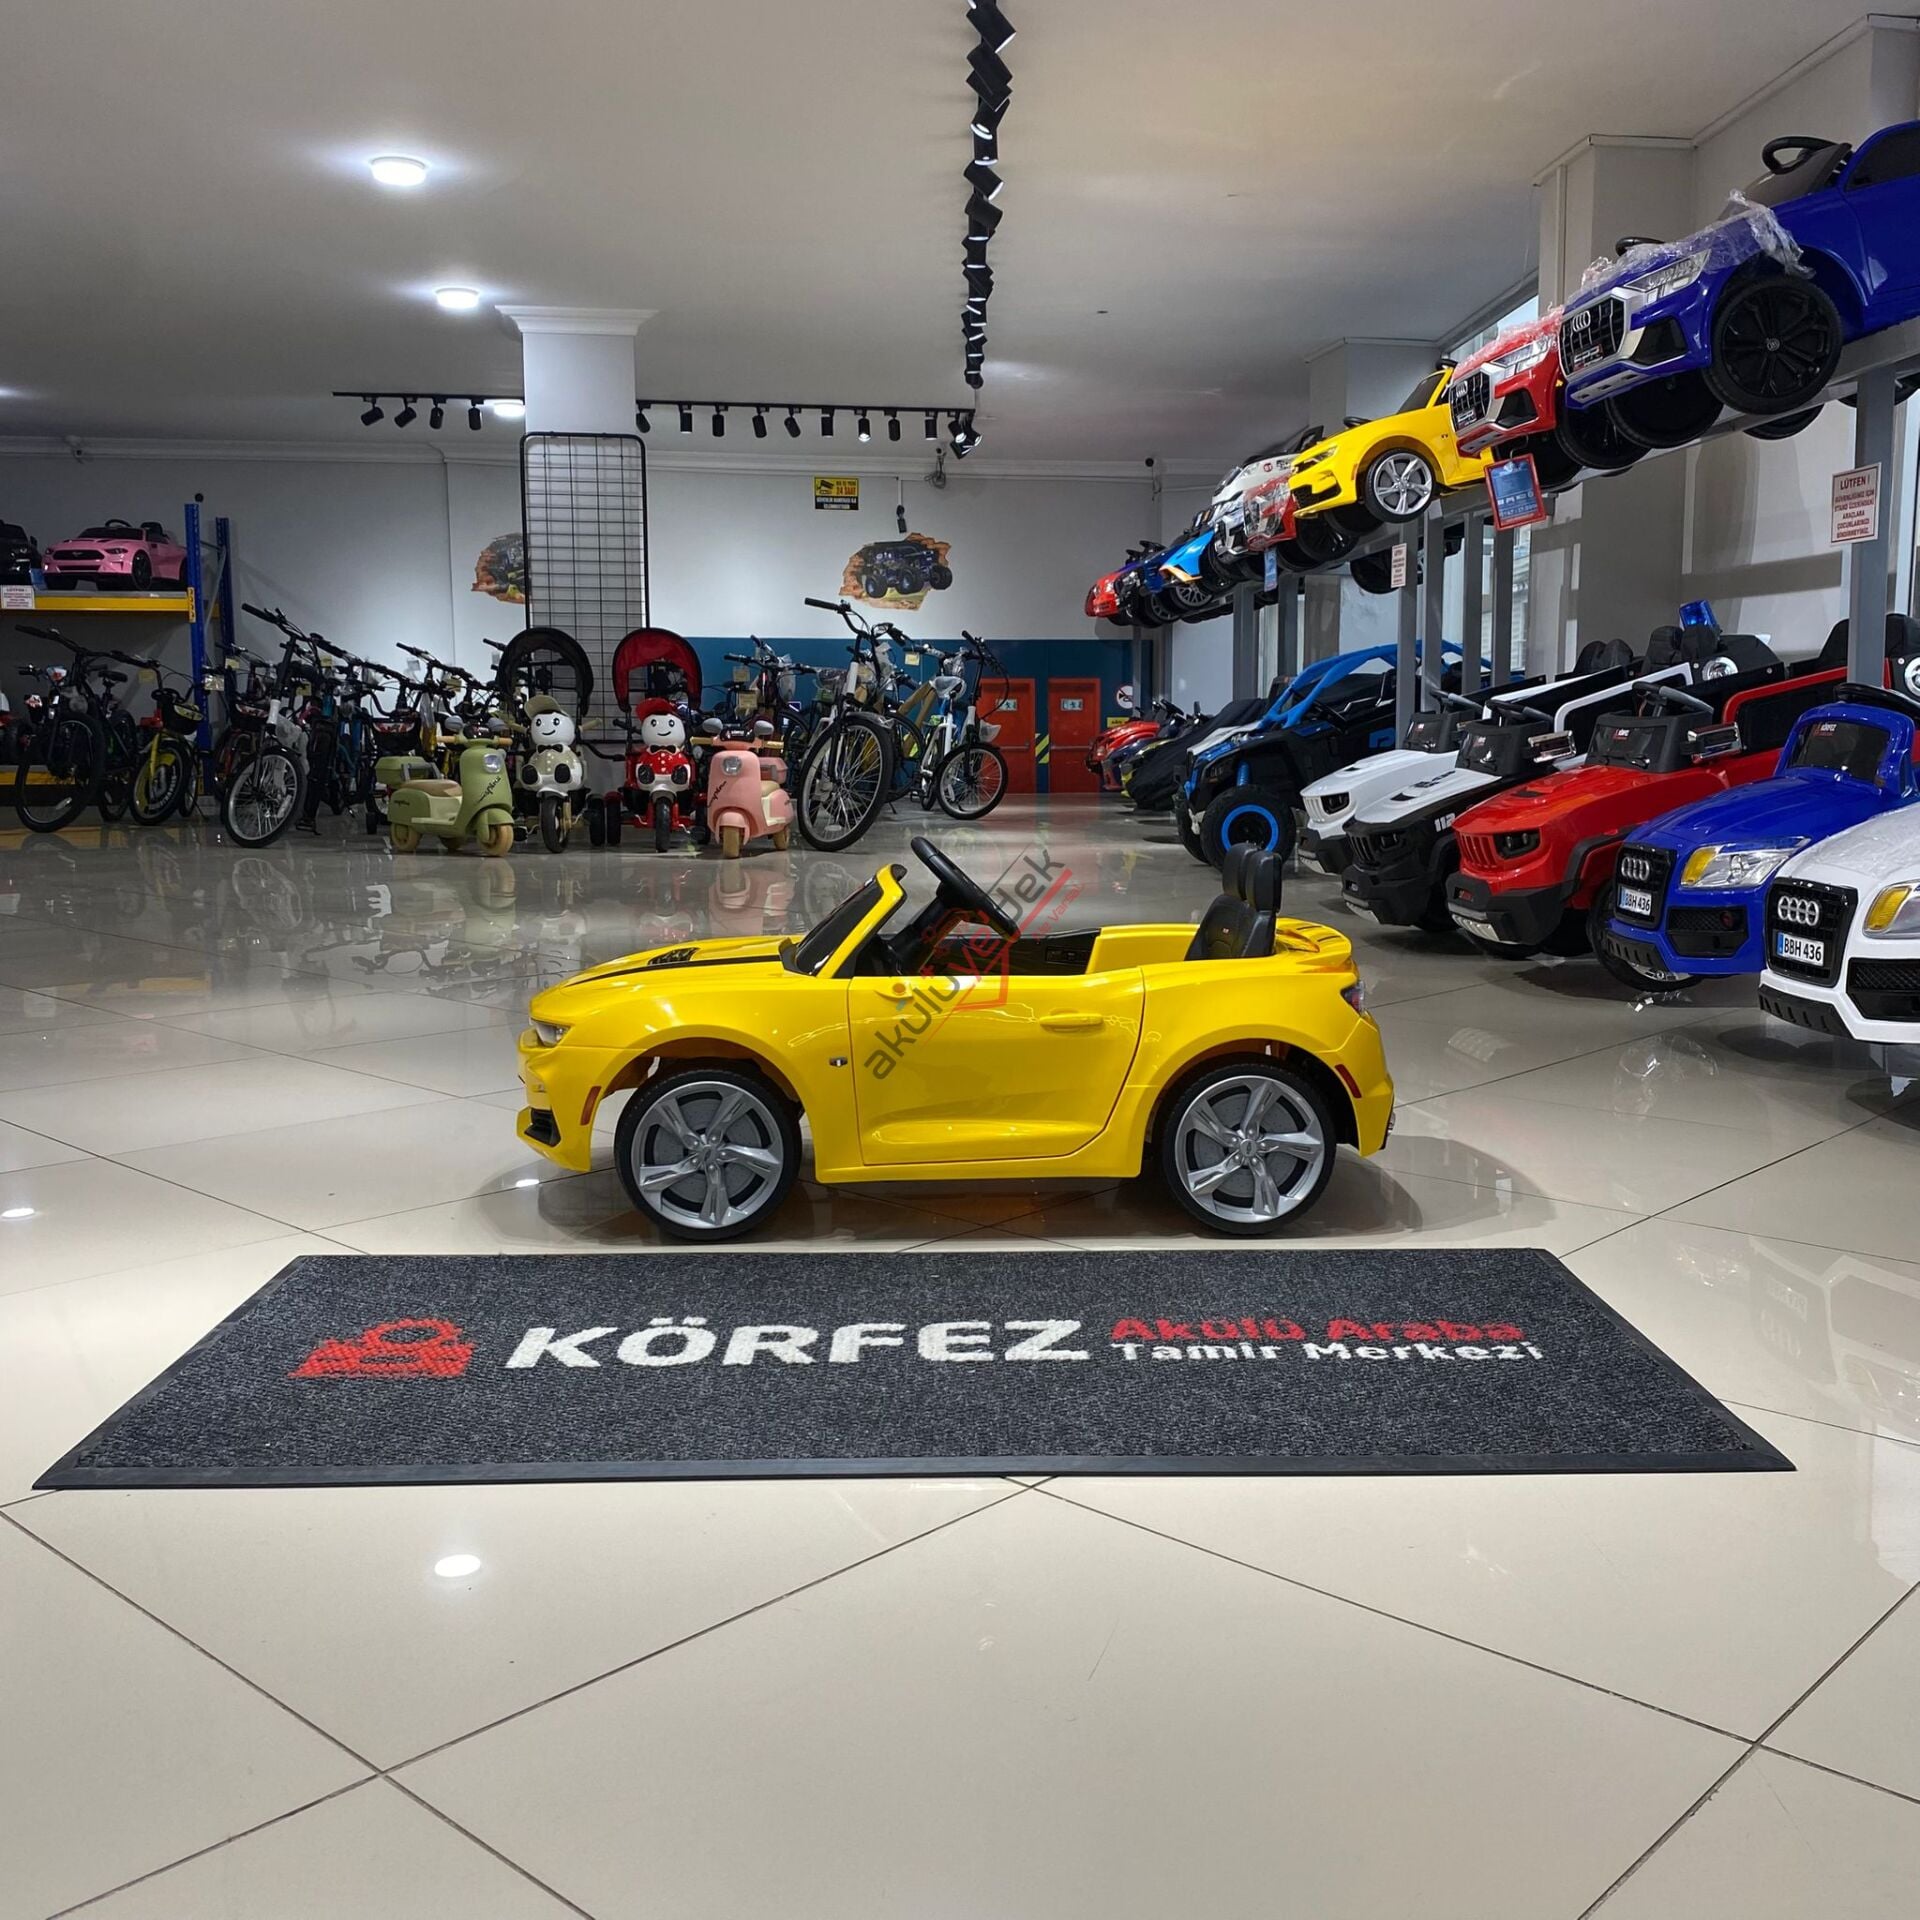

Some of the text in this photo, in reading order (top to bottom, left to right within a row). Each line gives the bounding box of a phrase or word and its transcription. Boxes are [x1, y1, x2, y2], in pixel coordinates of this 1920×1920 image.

[1840, 476, 1866, 490] LÜTFEN
[1637, 897, 1650, 912] 436
[1784, 937, 1822, 962] BBH 436
[1326, 1317, 1526, 1341] Araba
[505, 1316, 1090, 1368] KÖRFEZ
[1110, 1341, 1544, 1361] Tamir Merkezi
